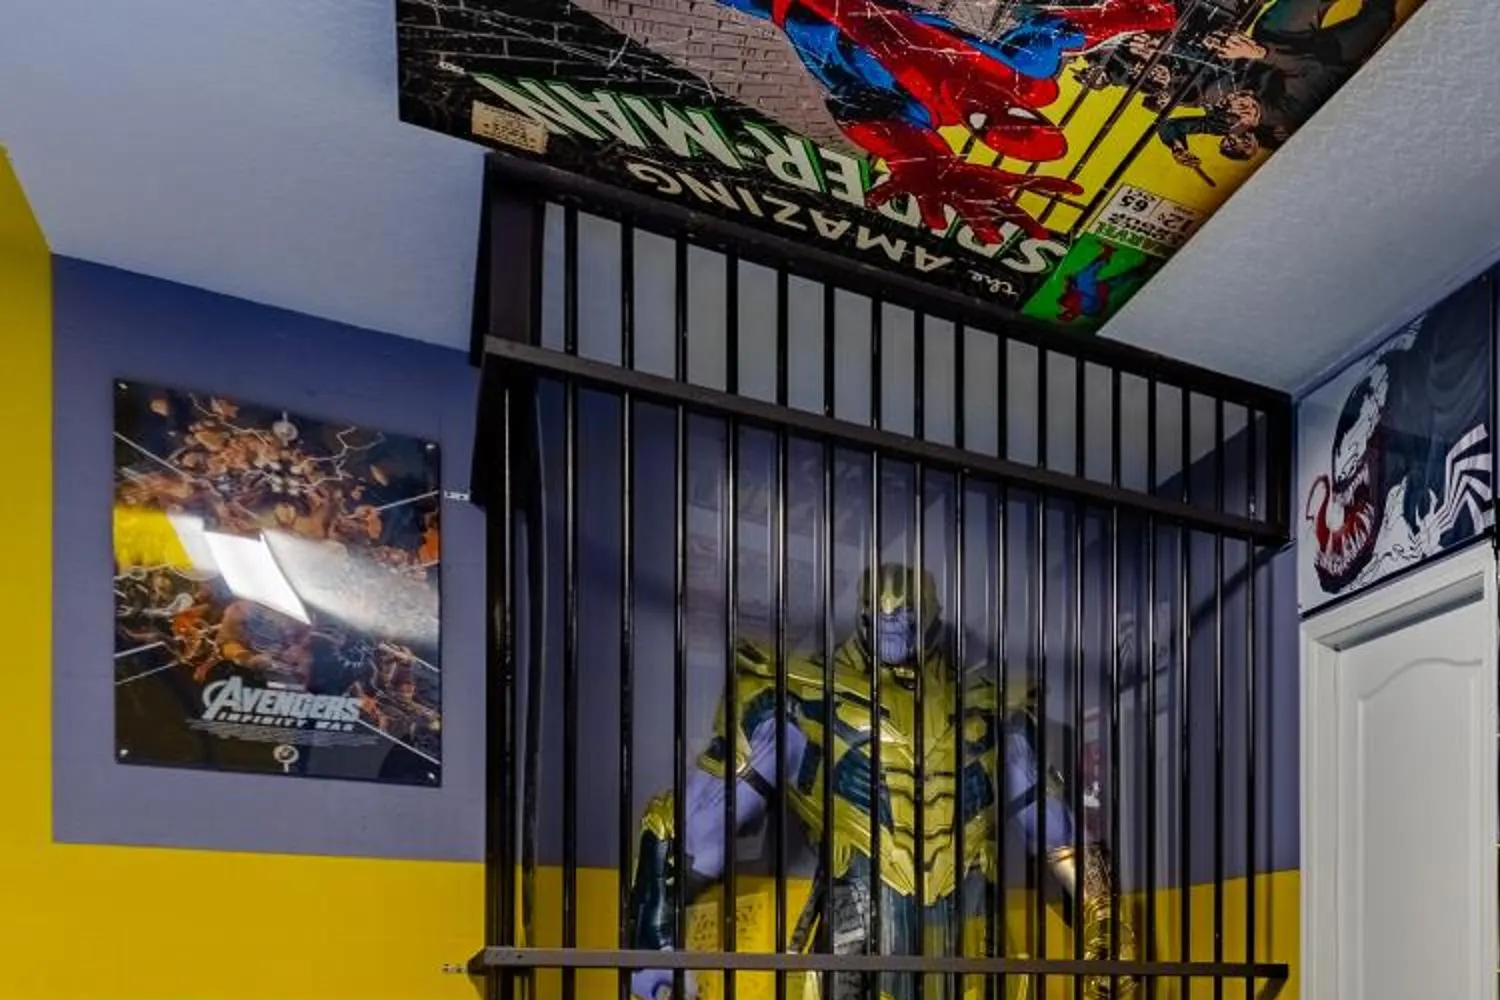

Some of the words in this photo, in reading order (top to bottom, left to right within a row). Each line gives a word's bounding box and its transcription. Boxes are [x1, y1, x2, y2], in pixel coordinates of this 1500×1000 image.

[624, 161, 953, 274] AMAZING
[1120, 194, 1149, 212] 65
[968, 268, 1021, 298] the
[202, 675, 361, 723] AVENGERS
